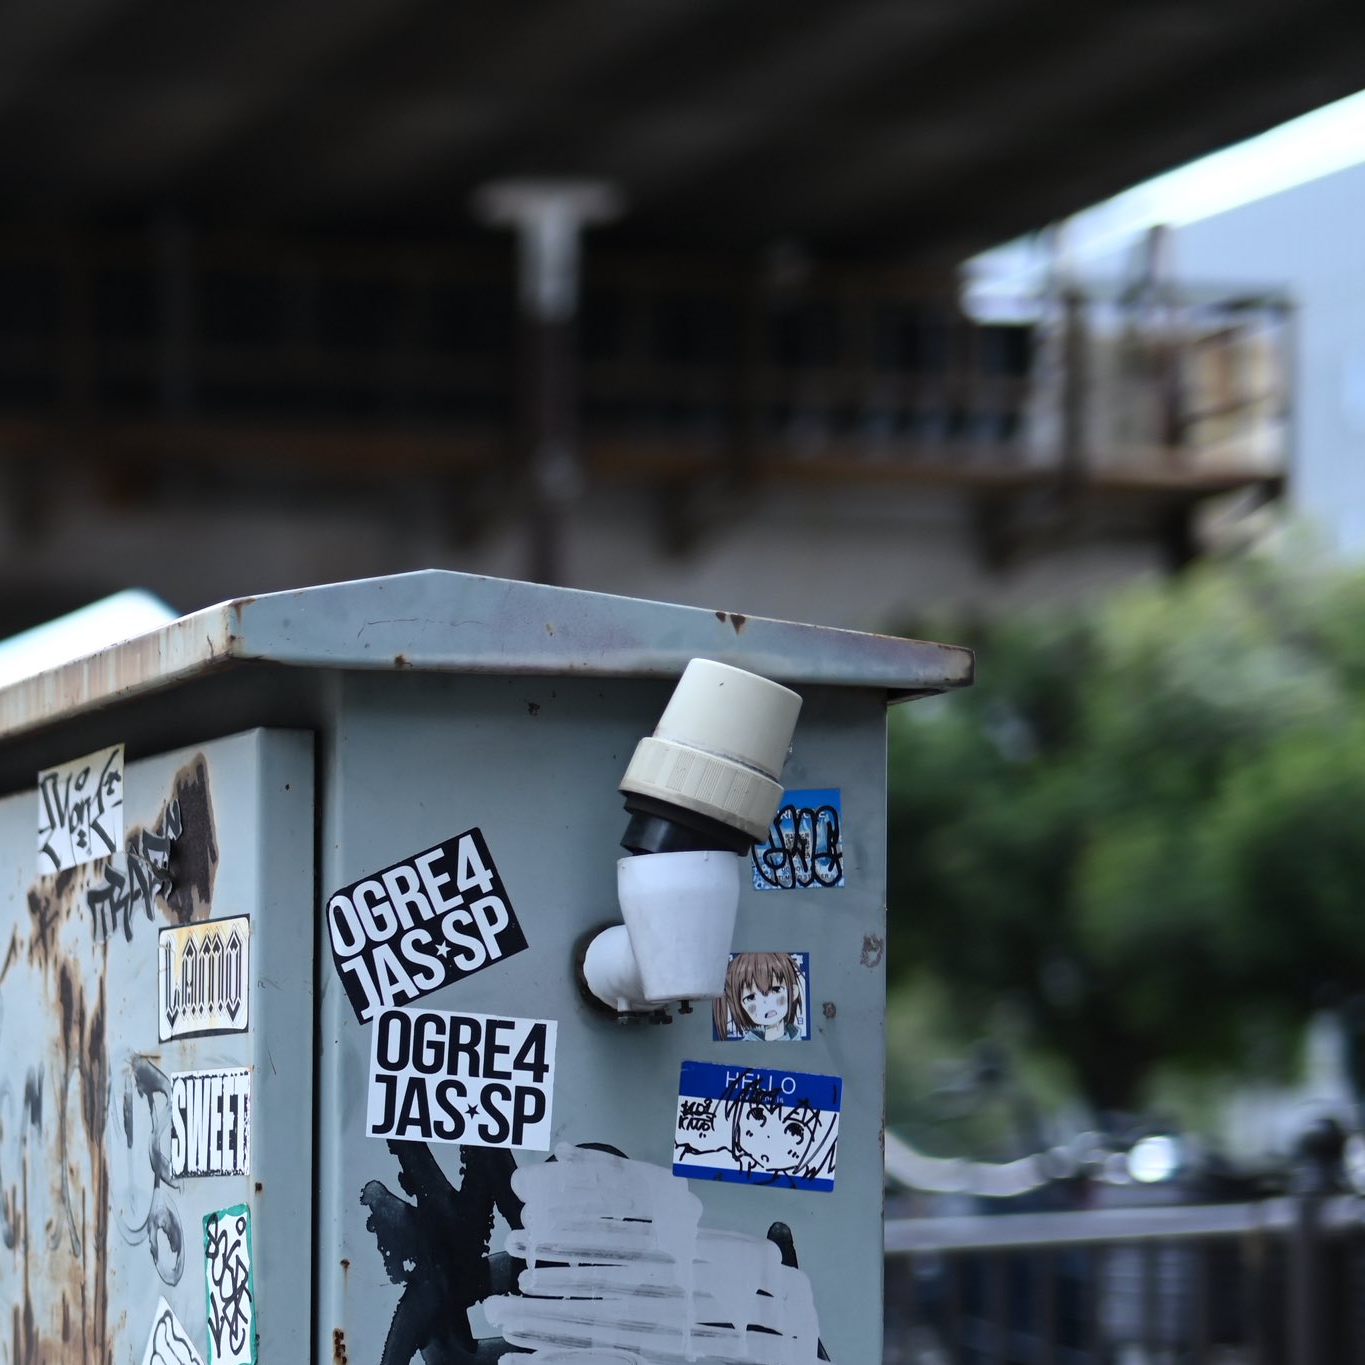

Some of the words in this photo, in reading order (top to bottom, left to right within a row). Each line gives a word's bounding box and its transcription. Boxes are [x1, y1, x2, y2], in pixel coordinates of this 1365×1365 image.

[329, 834, 493, 957] OGRE4
[376, 1010, 550, 1083] OGRE4
[171, 1074, 247, 1172] SWEET
